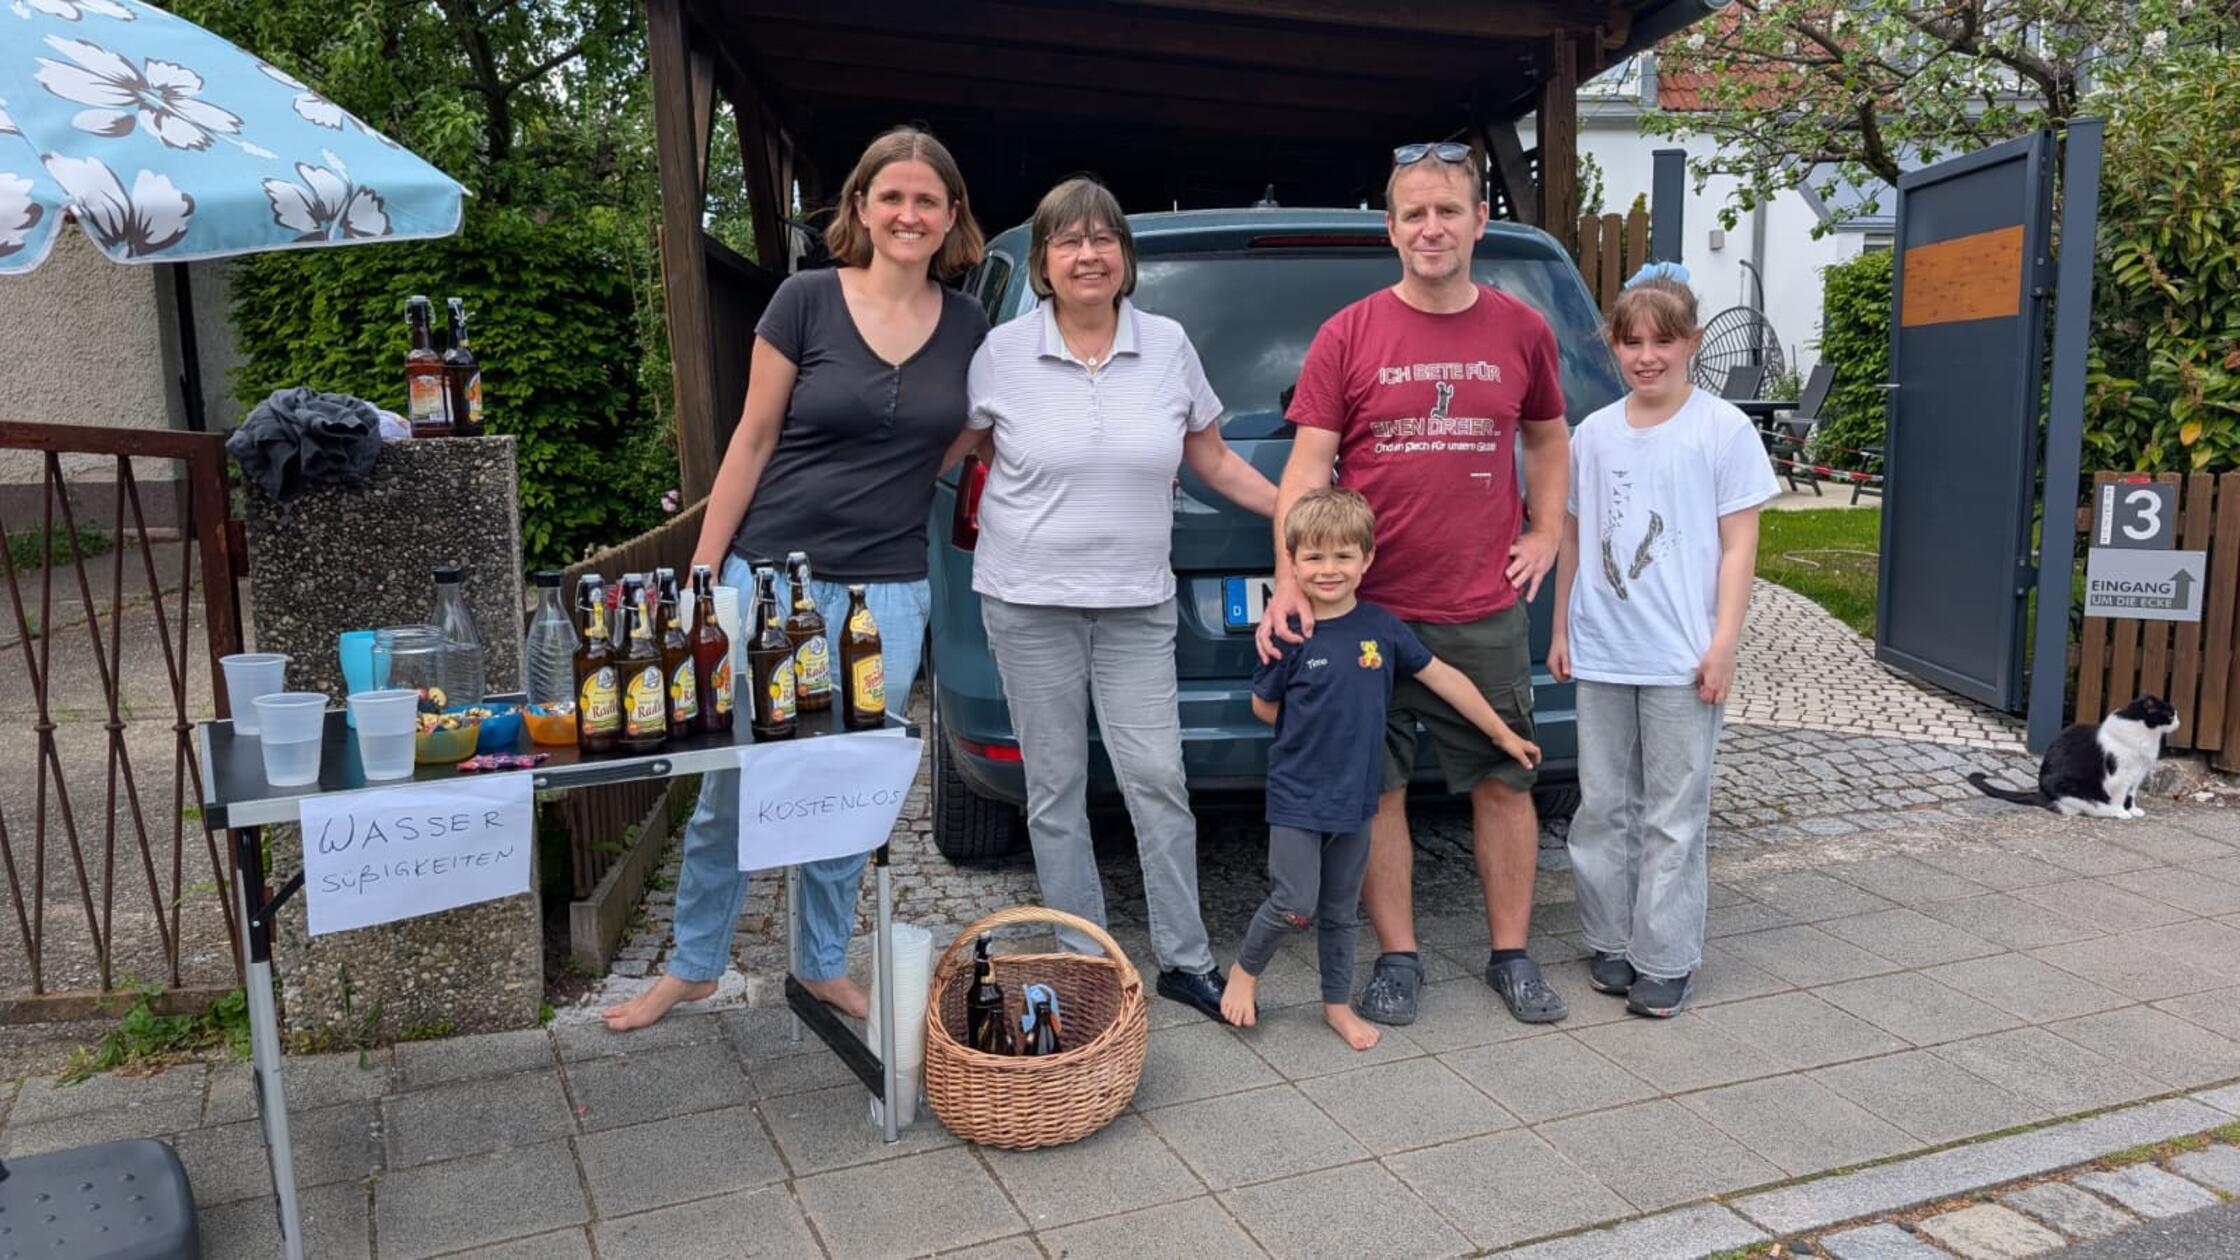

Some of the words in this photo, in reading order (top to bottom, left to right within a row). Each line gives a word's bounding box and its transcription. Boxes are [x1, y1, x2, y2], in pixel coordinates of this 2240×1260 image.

[1379, 366, 1411, 385] ICH
[1413, 363, 1464, 382] BETE
[1466, 360, 1502, 383] FÜR
[1370, 418, 1426, 438] EINEN
[1431, 440, 1446, 452] für
[2122, 489, 2162, 540] 3
[2091, 580, 2172, 595] EINGANG
[1232, 605, 1242, 617] D
[2091, 596, 2113, 606] UM
[2116, 597, 2137, 607] DIE
[2140, 597, 2172, 608] ECKE
[759, 789, 901, 824] KOSTENLOS
[318, 811, 504, 855] WASSER
